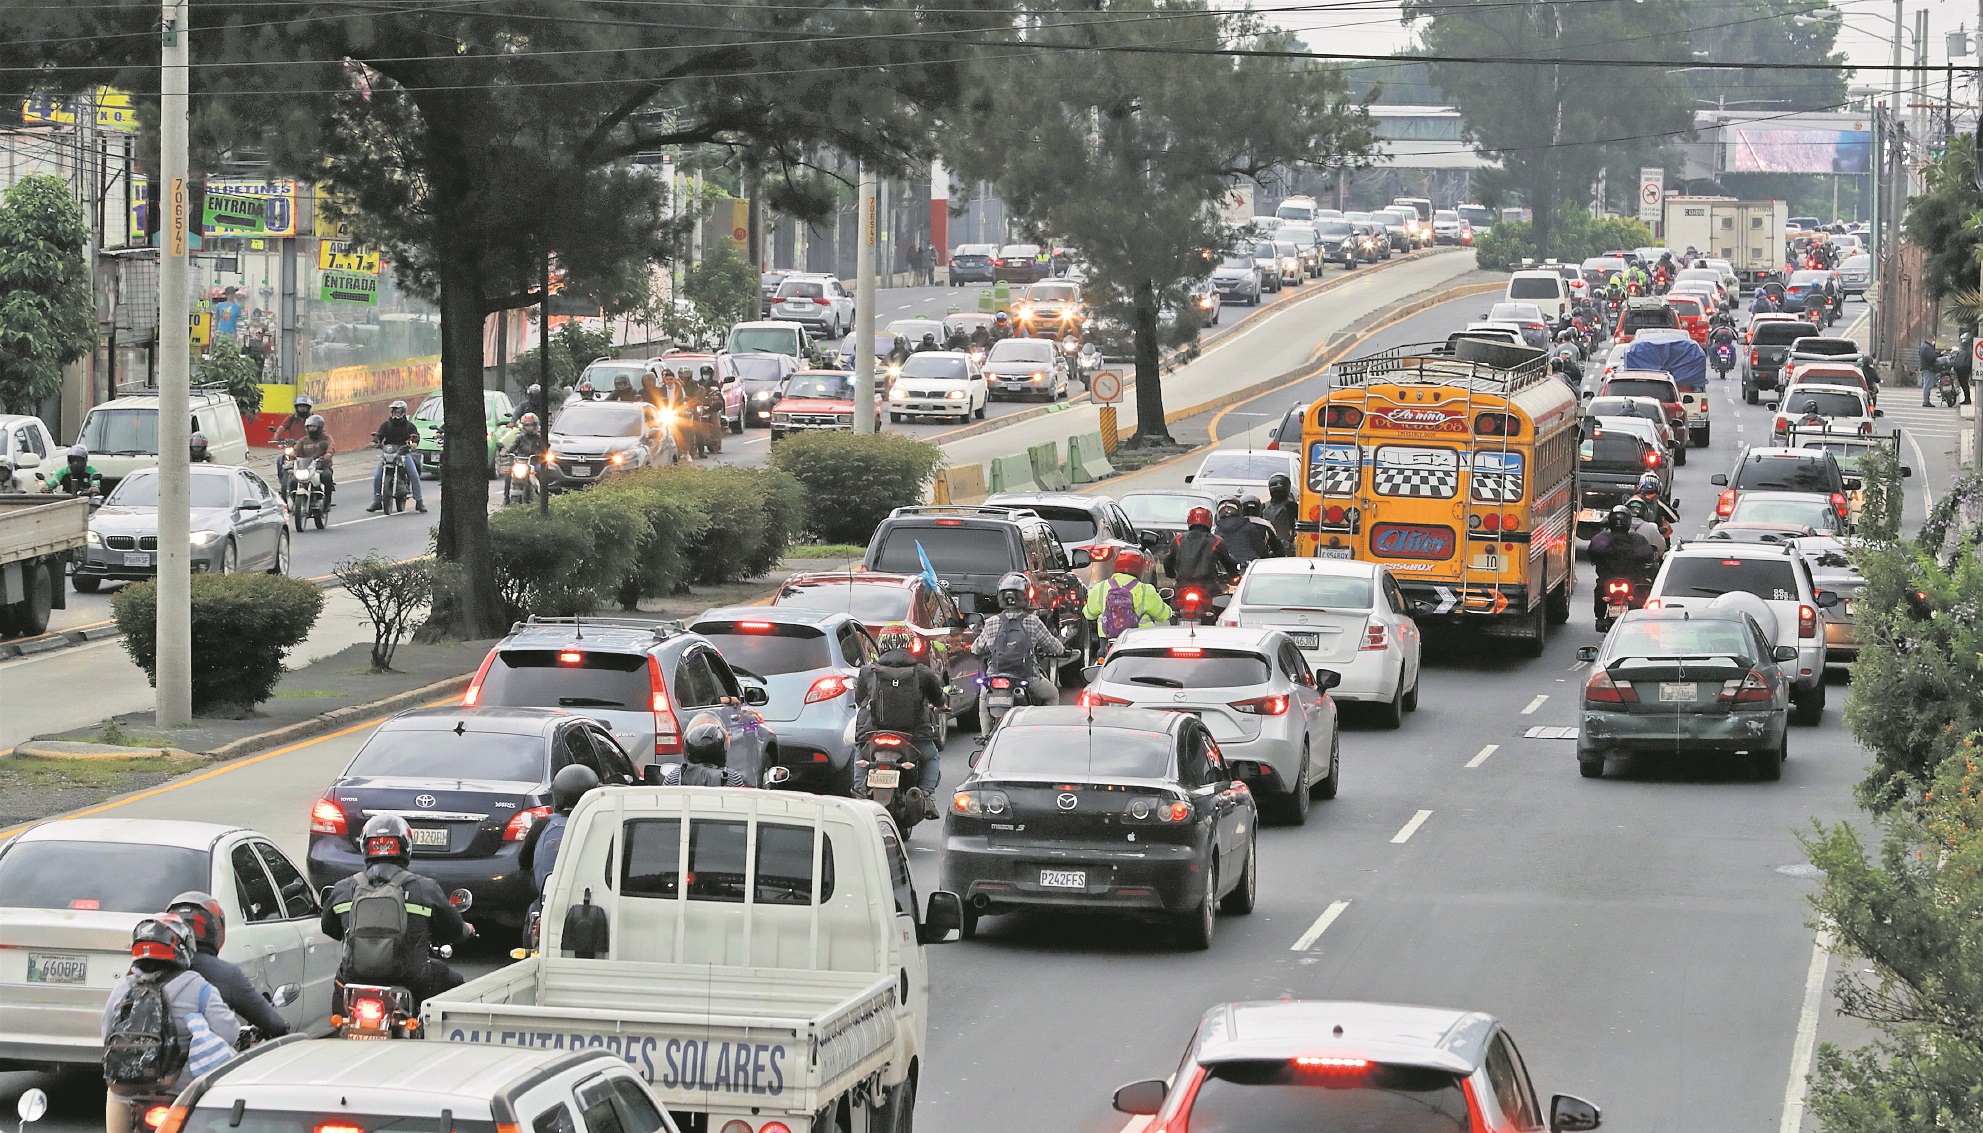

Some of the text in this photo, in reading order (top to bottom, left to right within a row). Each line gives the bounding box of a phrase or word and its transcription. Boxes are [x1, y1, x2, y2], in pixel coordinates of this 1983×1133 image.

[207, 197, 265, 217] ENTRADA
[174, 178, 183, 256] 706544
[328, 253, 337, 269] 7
[355, 255, 364, 270] 7
[324, 274, 376, 292] ENTRADA
[1485, 556, 1498, 573] 10
[495, 801, 516, 809] YARIS
[1041, 872, 1084, 886] P242FFS
[663, 1037, 786, 1097] SOLARES
